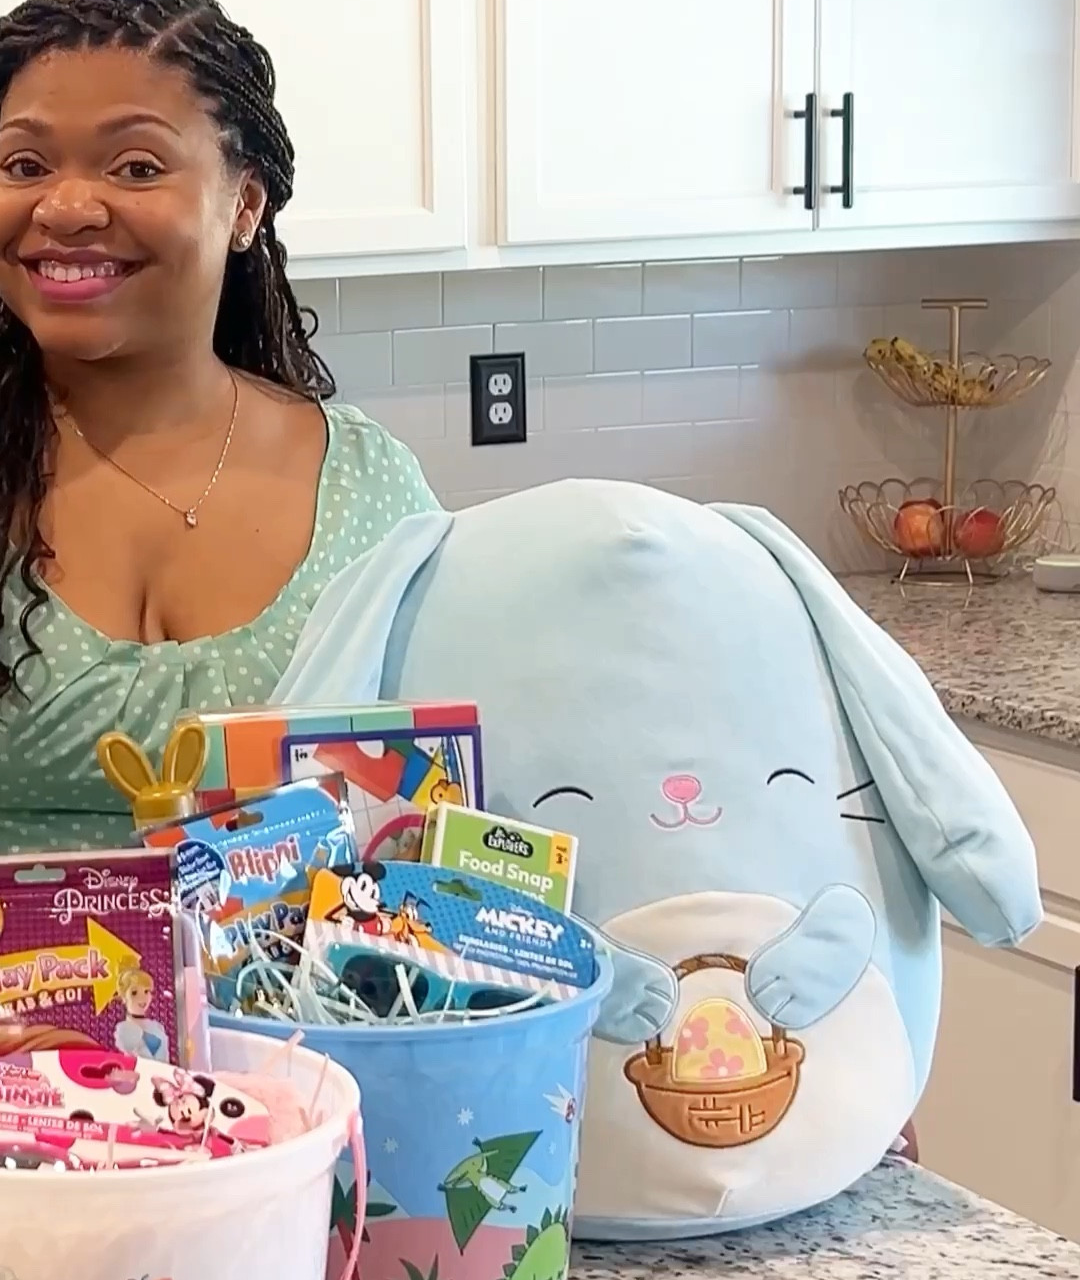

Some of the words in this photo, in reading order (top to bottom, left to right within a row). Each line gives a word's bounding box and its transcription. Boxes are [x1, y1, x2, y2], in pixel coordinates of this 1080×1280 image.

[227, 835, 300, 883] Blippi
[459, 851, 504, 875] Food
[506, 863, 554, 893] Snap
[475, 906, 565, 942] MICKEY
[483, 926, 507, 938] AND
[508, 932, 553, 950] FRIENDS
[37, 949, 110, 983] Pack
[37, 992, 53, 1009] &
[54, 989, 83, 1005] GO!
[66, 1122, 81, 1132] DE
[82, 1123, 104, 1134] SOL
